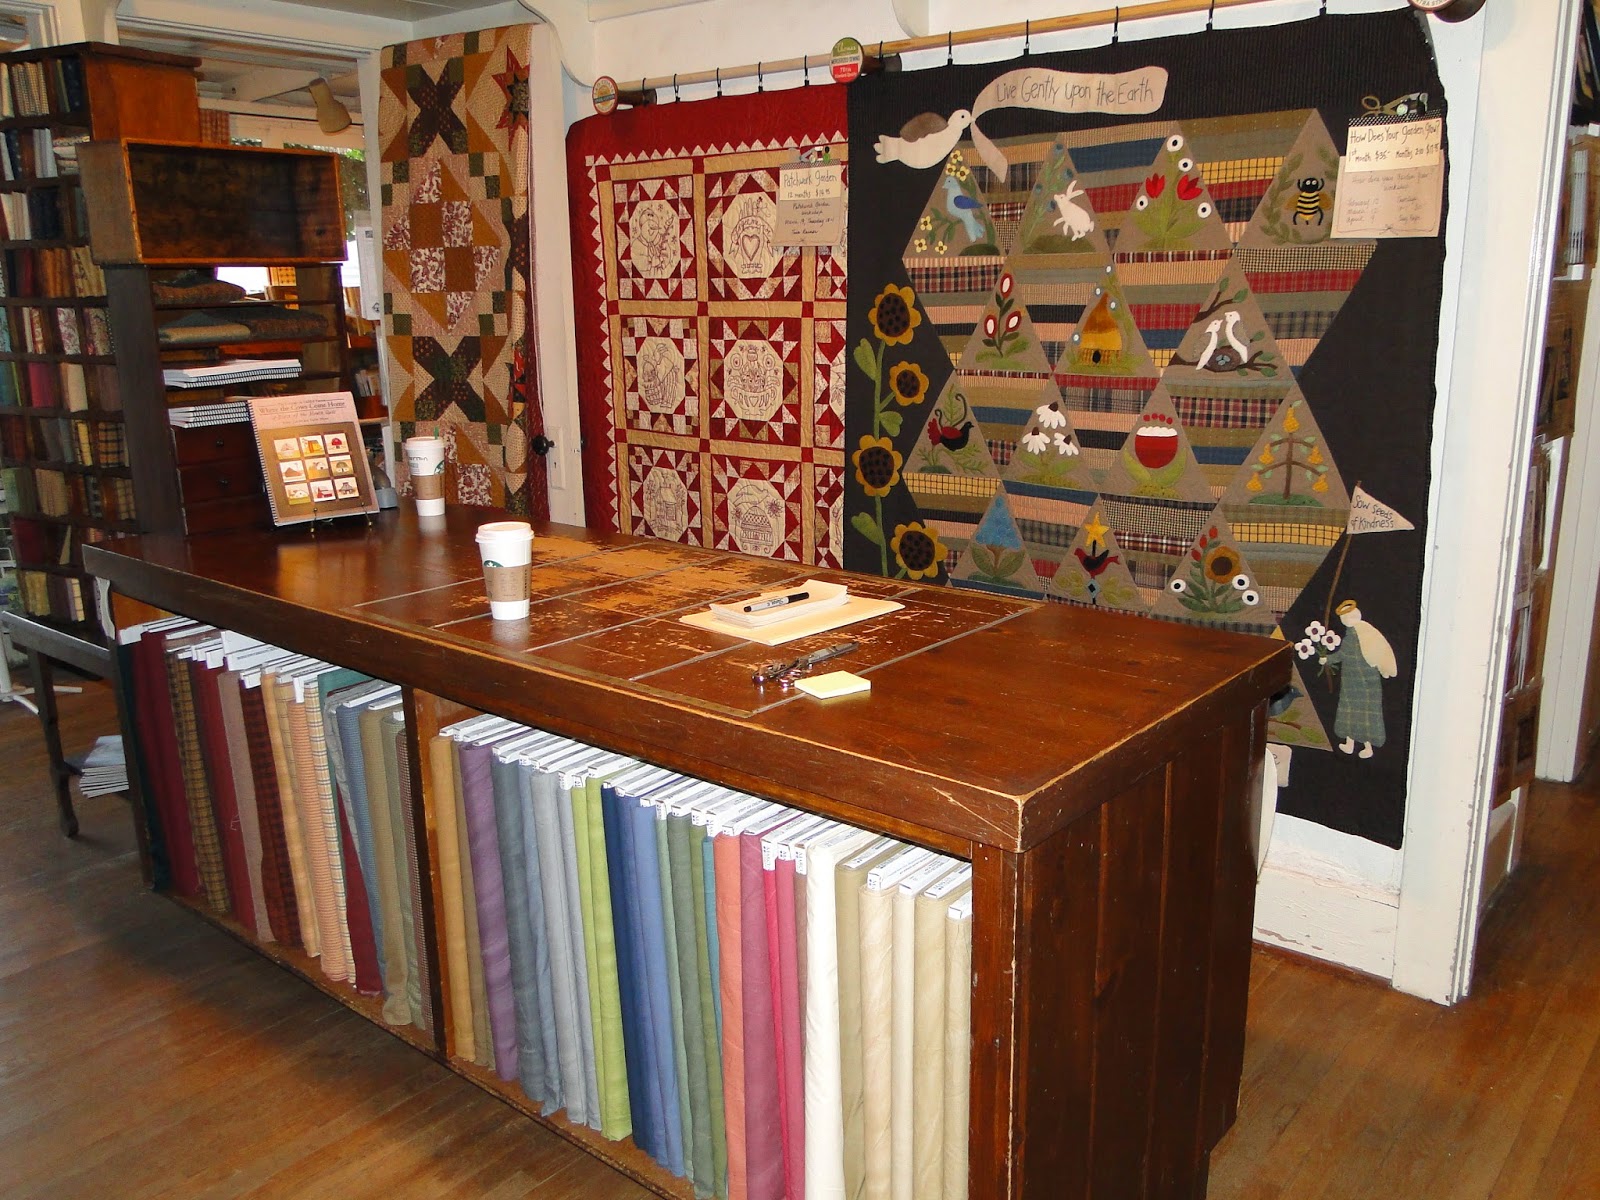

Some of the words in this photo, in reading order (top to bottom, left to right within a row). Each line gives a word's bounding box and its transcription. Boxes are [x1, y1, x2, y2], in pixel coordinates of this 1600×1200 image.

[996, 81, 1017, 102] Live
[1021, 75, 1060, 104] Gently
[1097, 80, 1114, 106] the
[1118, 76, 1153, 105] Earth
[1350, 130, 1367, 144] How
[1368, 128, 1384, 143] Does
[1385, 126, 1399, 141] Your
[783, 171, 813, 188] Patchwork
[1353, 495, 1370, 509] Sow
[1351, 517, 1359, 530] of
[1358, 517, 1394, 530] Kindness
